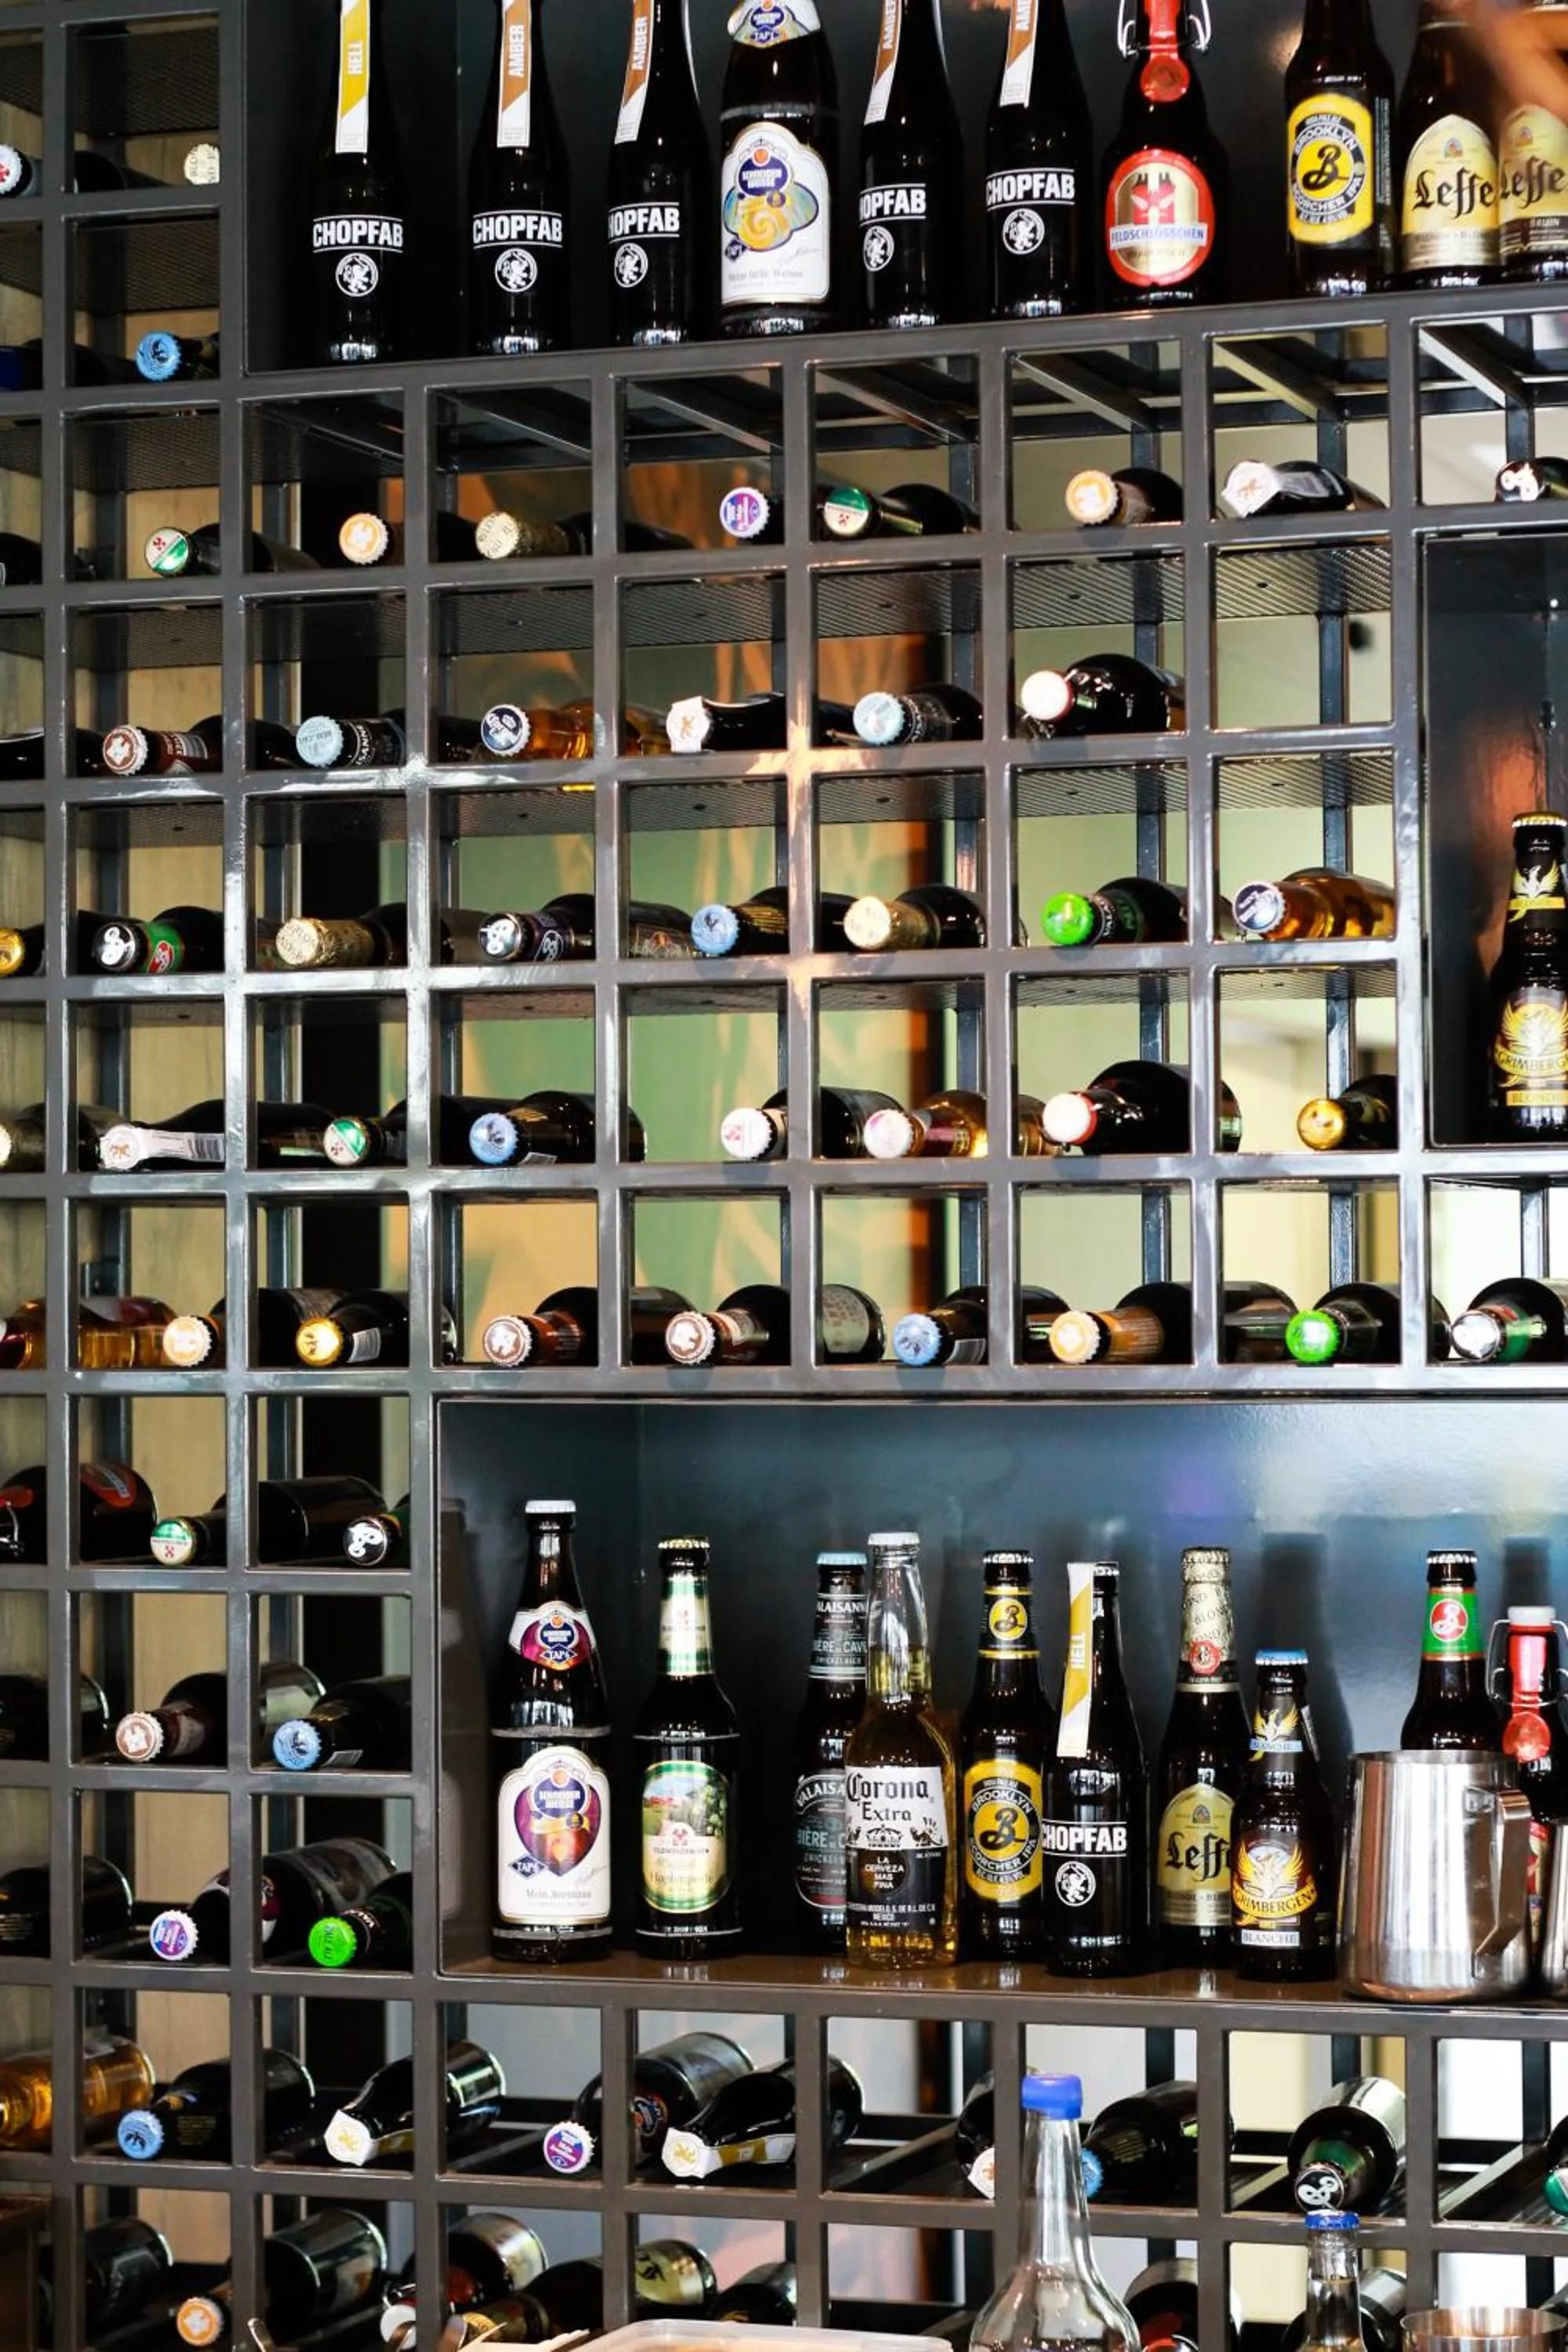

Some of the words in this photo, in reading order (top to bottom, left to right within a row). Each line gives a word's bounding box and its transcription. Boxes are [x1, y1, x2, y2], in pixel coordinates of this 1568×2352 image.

[347, 39, 363, 75] HELL
[509, 24, 524, 77] AMBER
[632, 16, 648, 71] AMBER
[1294, 125, 1358, 155] BROOKLYN
[986, 172, 1075, 206] CHOPFAB
[1412, 165, 1496, 220] Leffe
[314, 220, 403, 248] CHOPFAB
[473, 215, 563, 245] CHOPFAB
[1071, 1632, 1085, 1669] HELL
[847, 1773, 929, 1802] Corona
[862, 1801, 912, 1821] Extra
[971, 1790, 1033, 1814] BROOKLYN
[865, 1864, 905, 1874] CERVEZA
[877, 1856, 890, 1864] LA
[873, 1872, 894, 1881] MAS
[873, 1880, 895, 1889] FINA
[1235, 1887, 1312, 1913] GRIMBERGEN
[1242, 1932, 1297, 1945] BLANCHE
